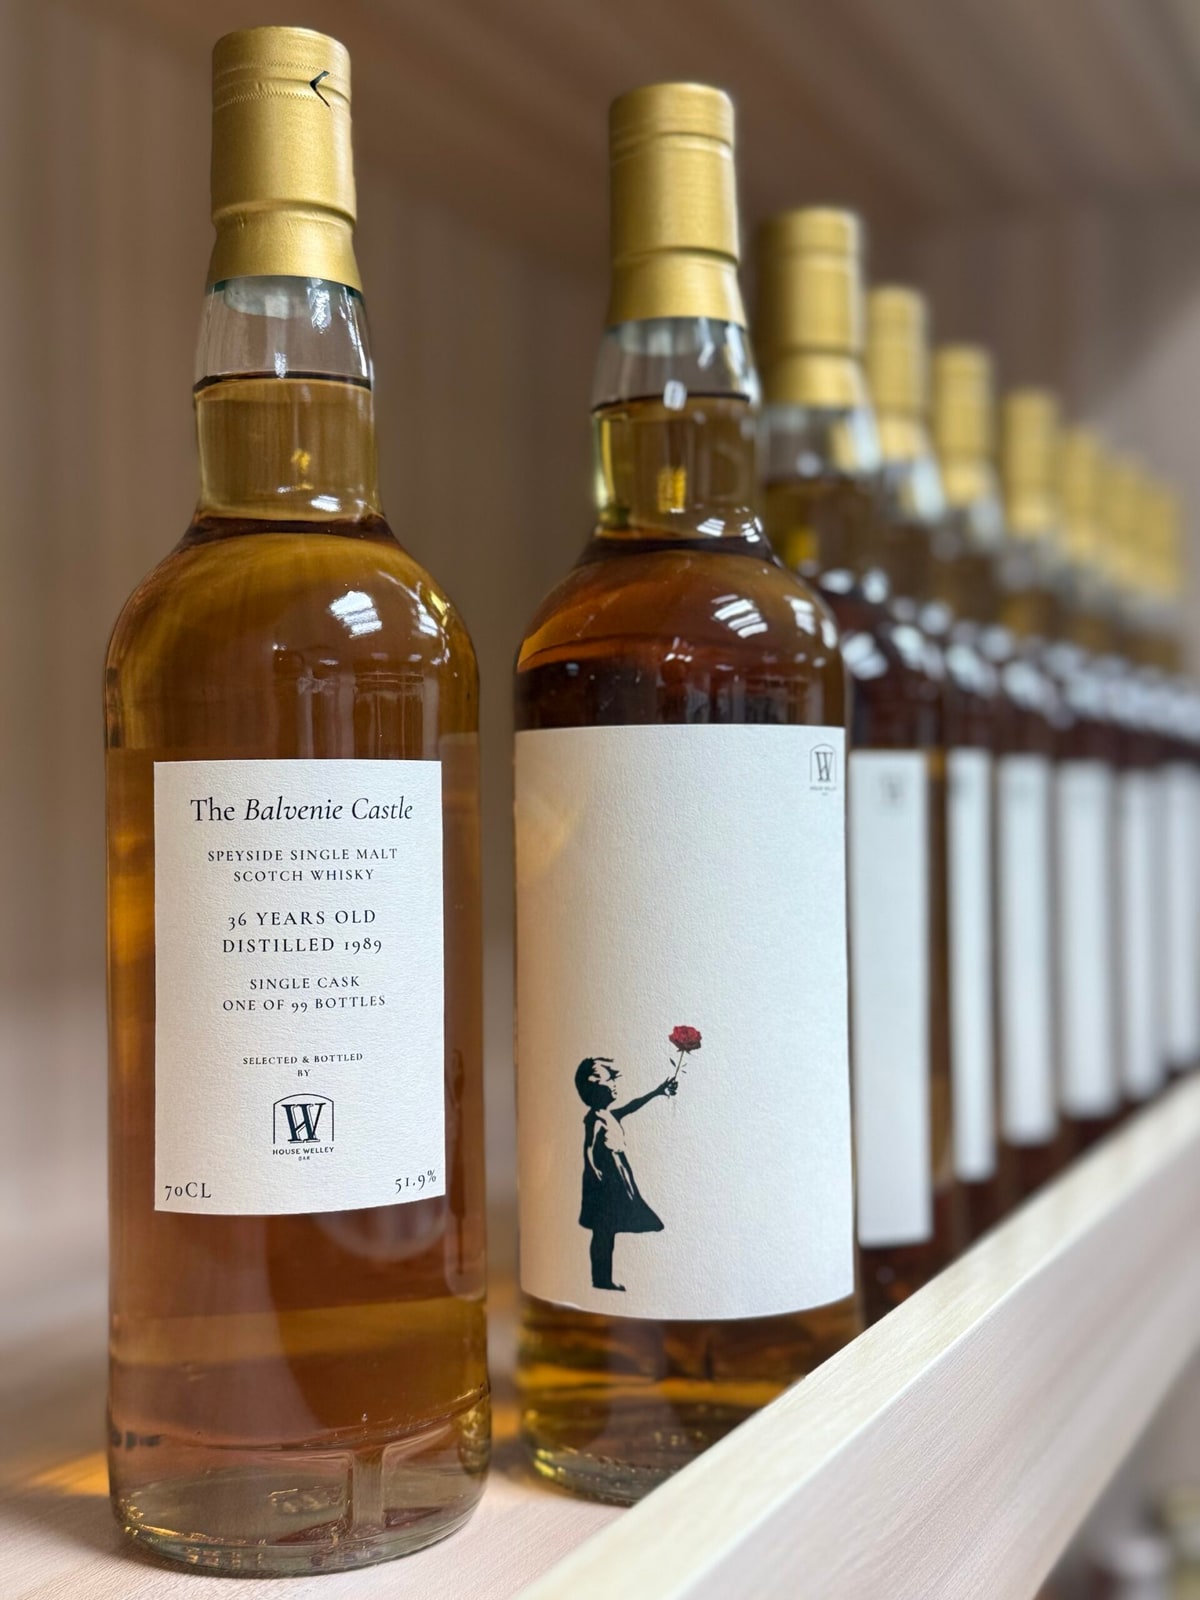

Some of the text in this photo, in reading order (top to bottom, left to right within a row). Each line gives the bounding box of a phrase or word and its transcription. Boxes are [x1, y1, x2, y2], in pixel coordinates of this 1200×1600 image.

[191, 796, 413, 822] The Balvenie Castle
[207, 848, 398, 862] SPEYSIDE SINGLE MALT
[233, 869, 374, 882] SCOTCH WHISKY
[228, 910, 376, 930] 36 YEARS OLD
[222, 938, 382, 955] DISTILLED 1989
[250, 976, 360, 990] SINGLE CASK
[222, 996, 386, 1013] ONE OF 99 BOTTLES
[243, 1053, 363, 1065] SELECTED & BOTTLED
[297, 1069, 311, 1077] BY
[272, 1146, 334, 1156] HOUSE WELLEY
[395, 1169, 437, 1194] 51.9%
[164, 1181, 212, 1200] 70CL
